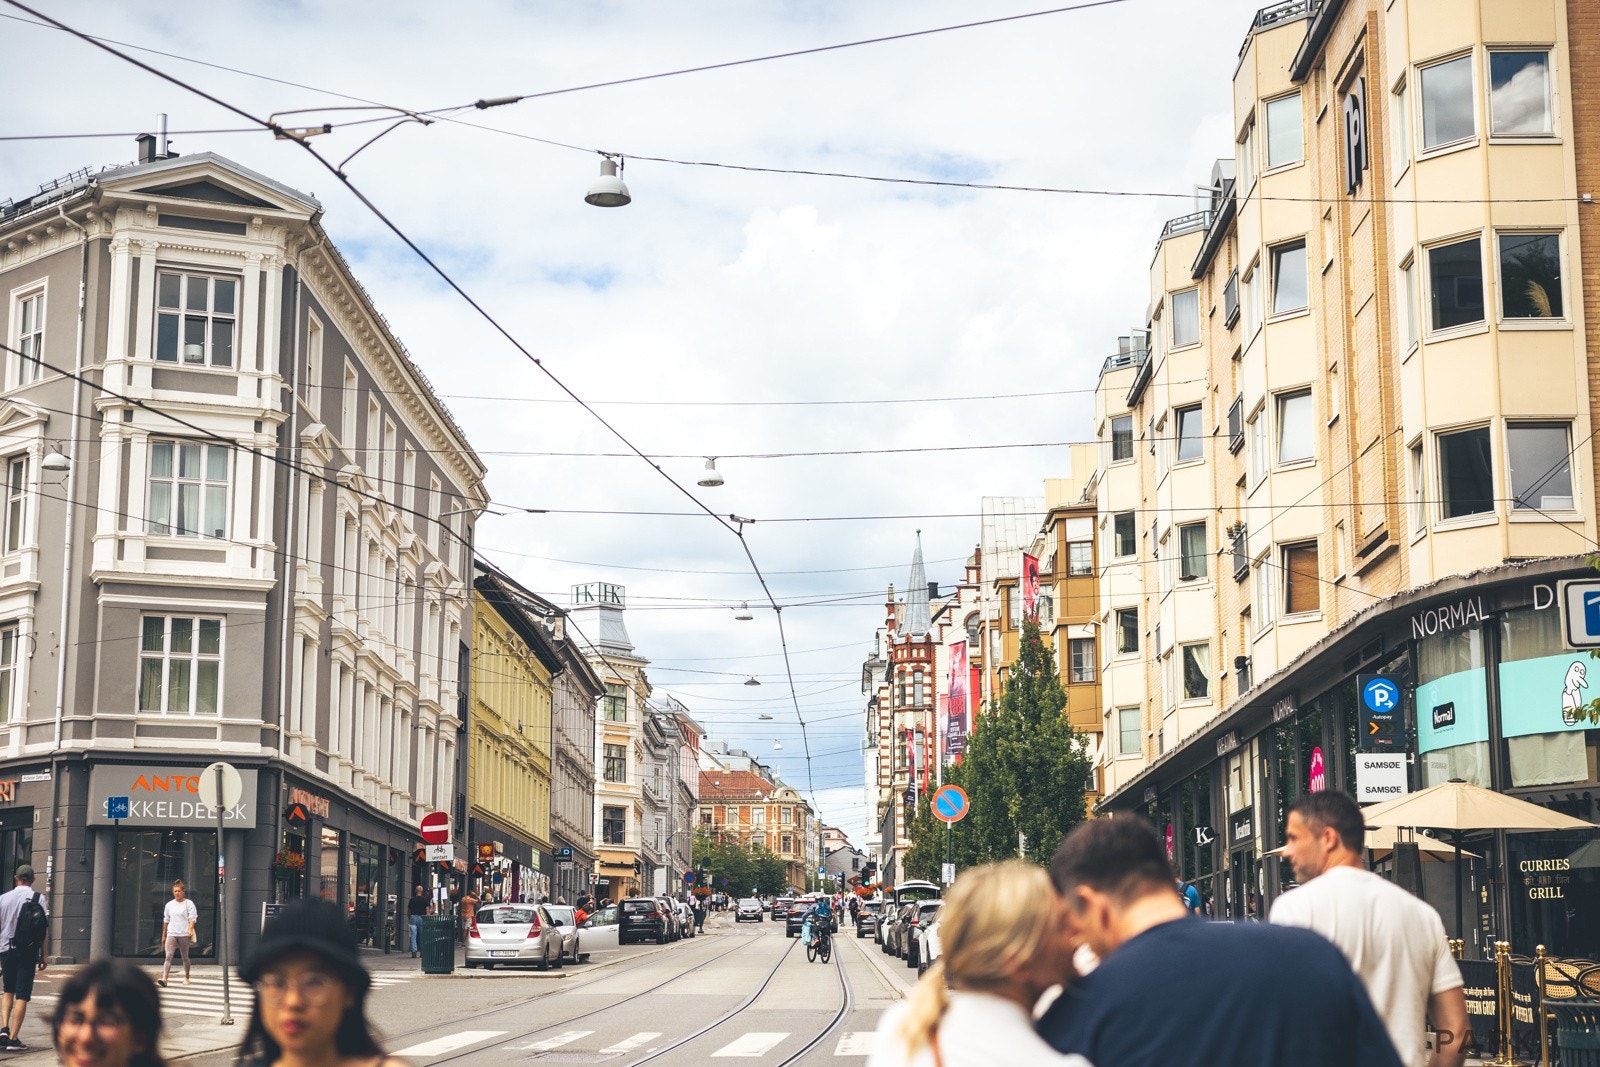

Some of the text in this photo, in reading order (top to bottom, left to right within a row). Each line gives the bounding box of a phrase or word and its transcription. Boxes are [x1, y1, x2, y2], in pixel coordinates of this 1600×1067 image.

[1411, 584, 1561, 640] NORMAL D
[1375, 689, 1389, 706] P
[1434, 707, 1453, 724] Normal
[132, 774, 200, 793] ANTO
[1520, 859, 1570, 872] CURRIES
[1529, 887, 1564, 899] GRILL
